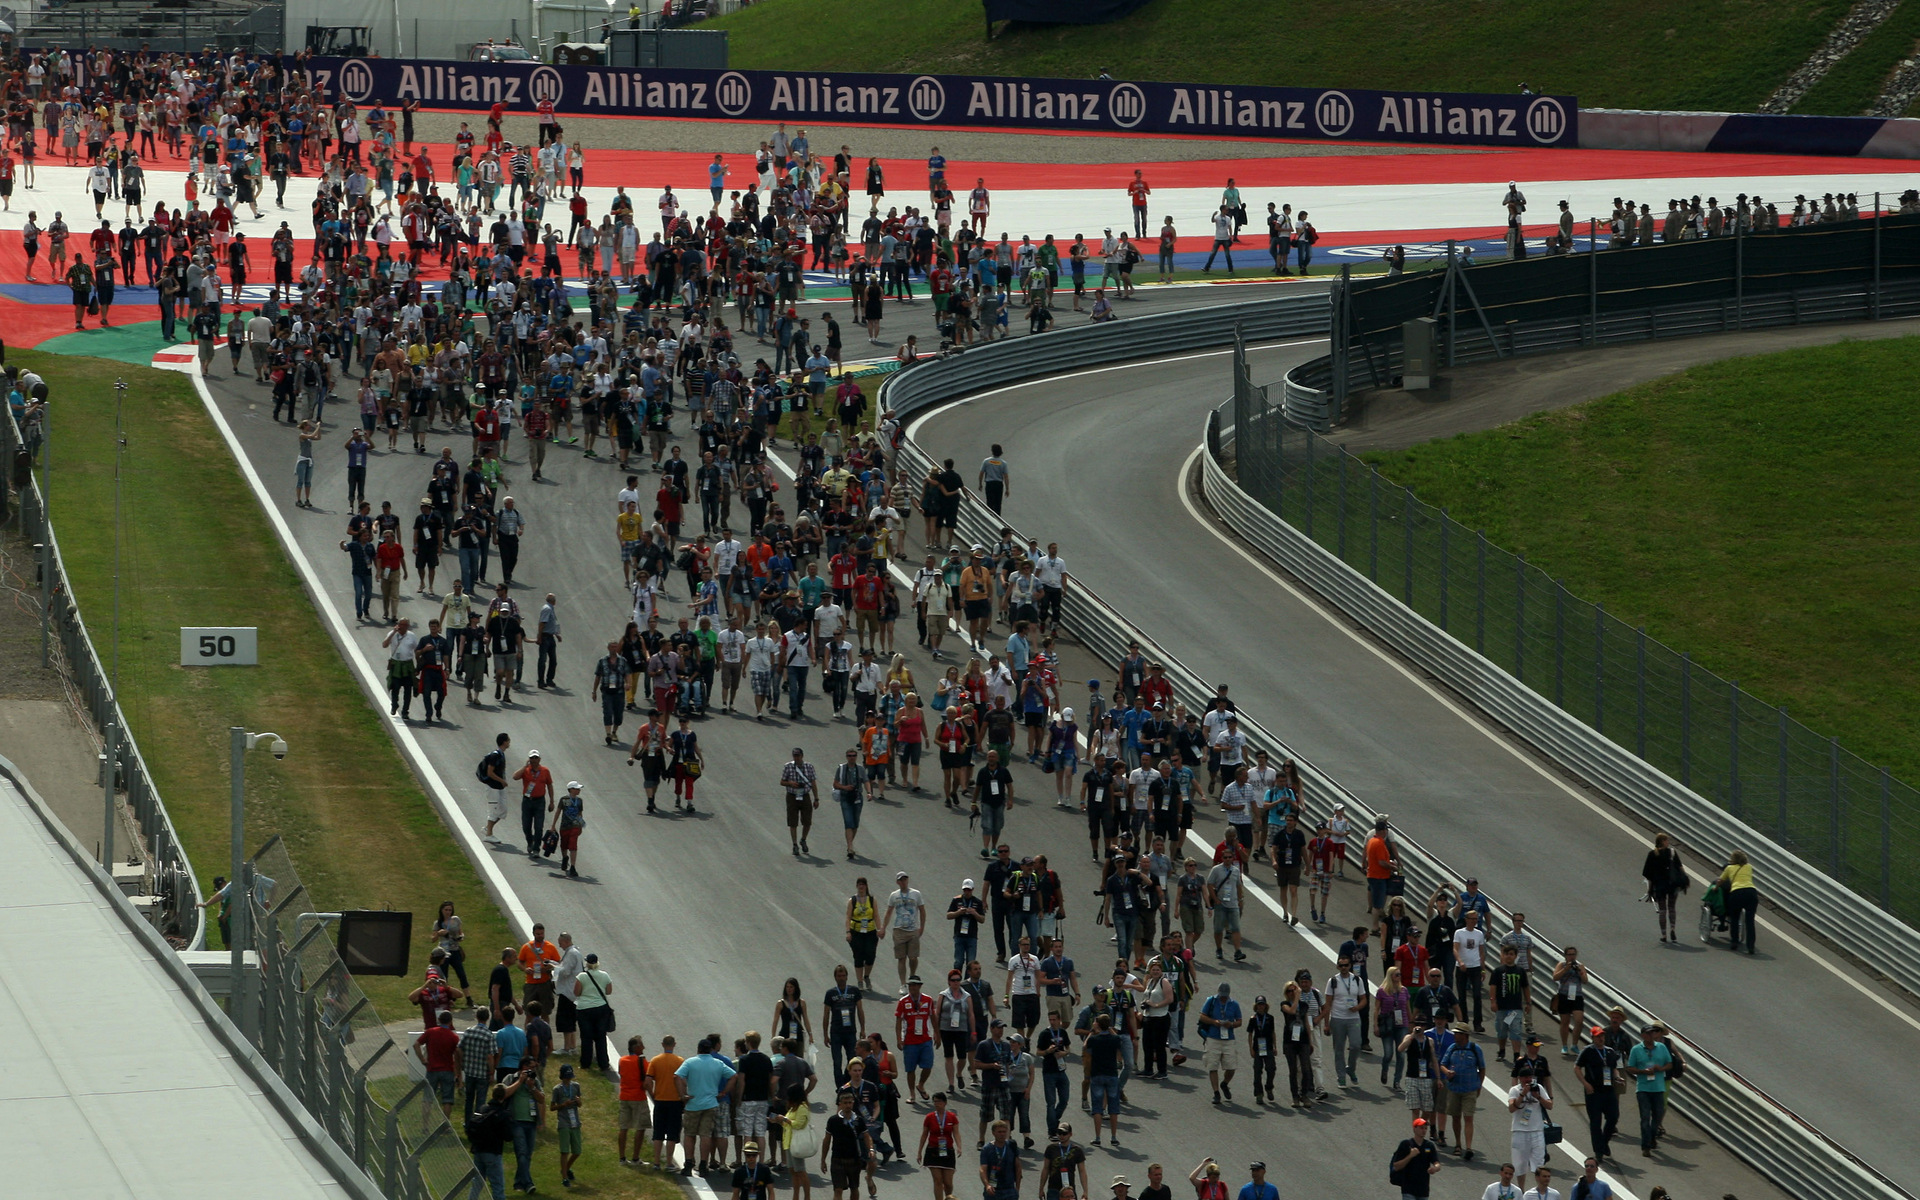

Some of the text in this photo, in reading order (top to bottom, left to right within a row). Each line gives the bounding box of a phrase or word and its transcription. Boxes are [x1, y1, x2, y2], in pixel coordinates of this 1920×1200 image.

[396, 65, 521, 103] Allianz
[583, 71, 708, 109] Allianz
[769, 76, 899, 114] Allianz
[967, 82, 1100, 121] Allianz
[1168, 88, 1305, 129] Allianz
[1378, 96, 1517, 136] Allianz
[199, 635, 236, 657] 50
